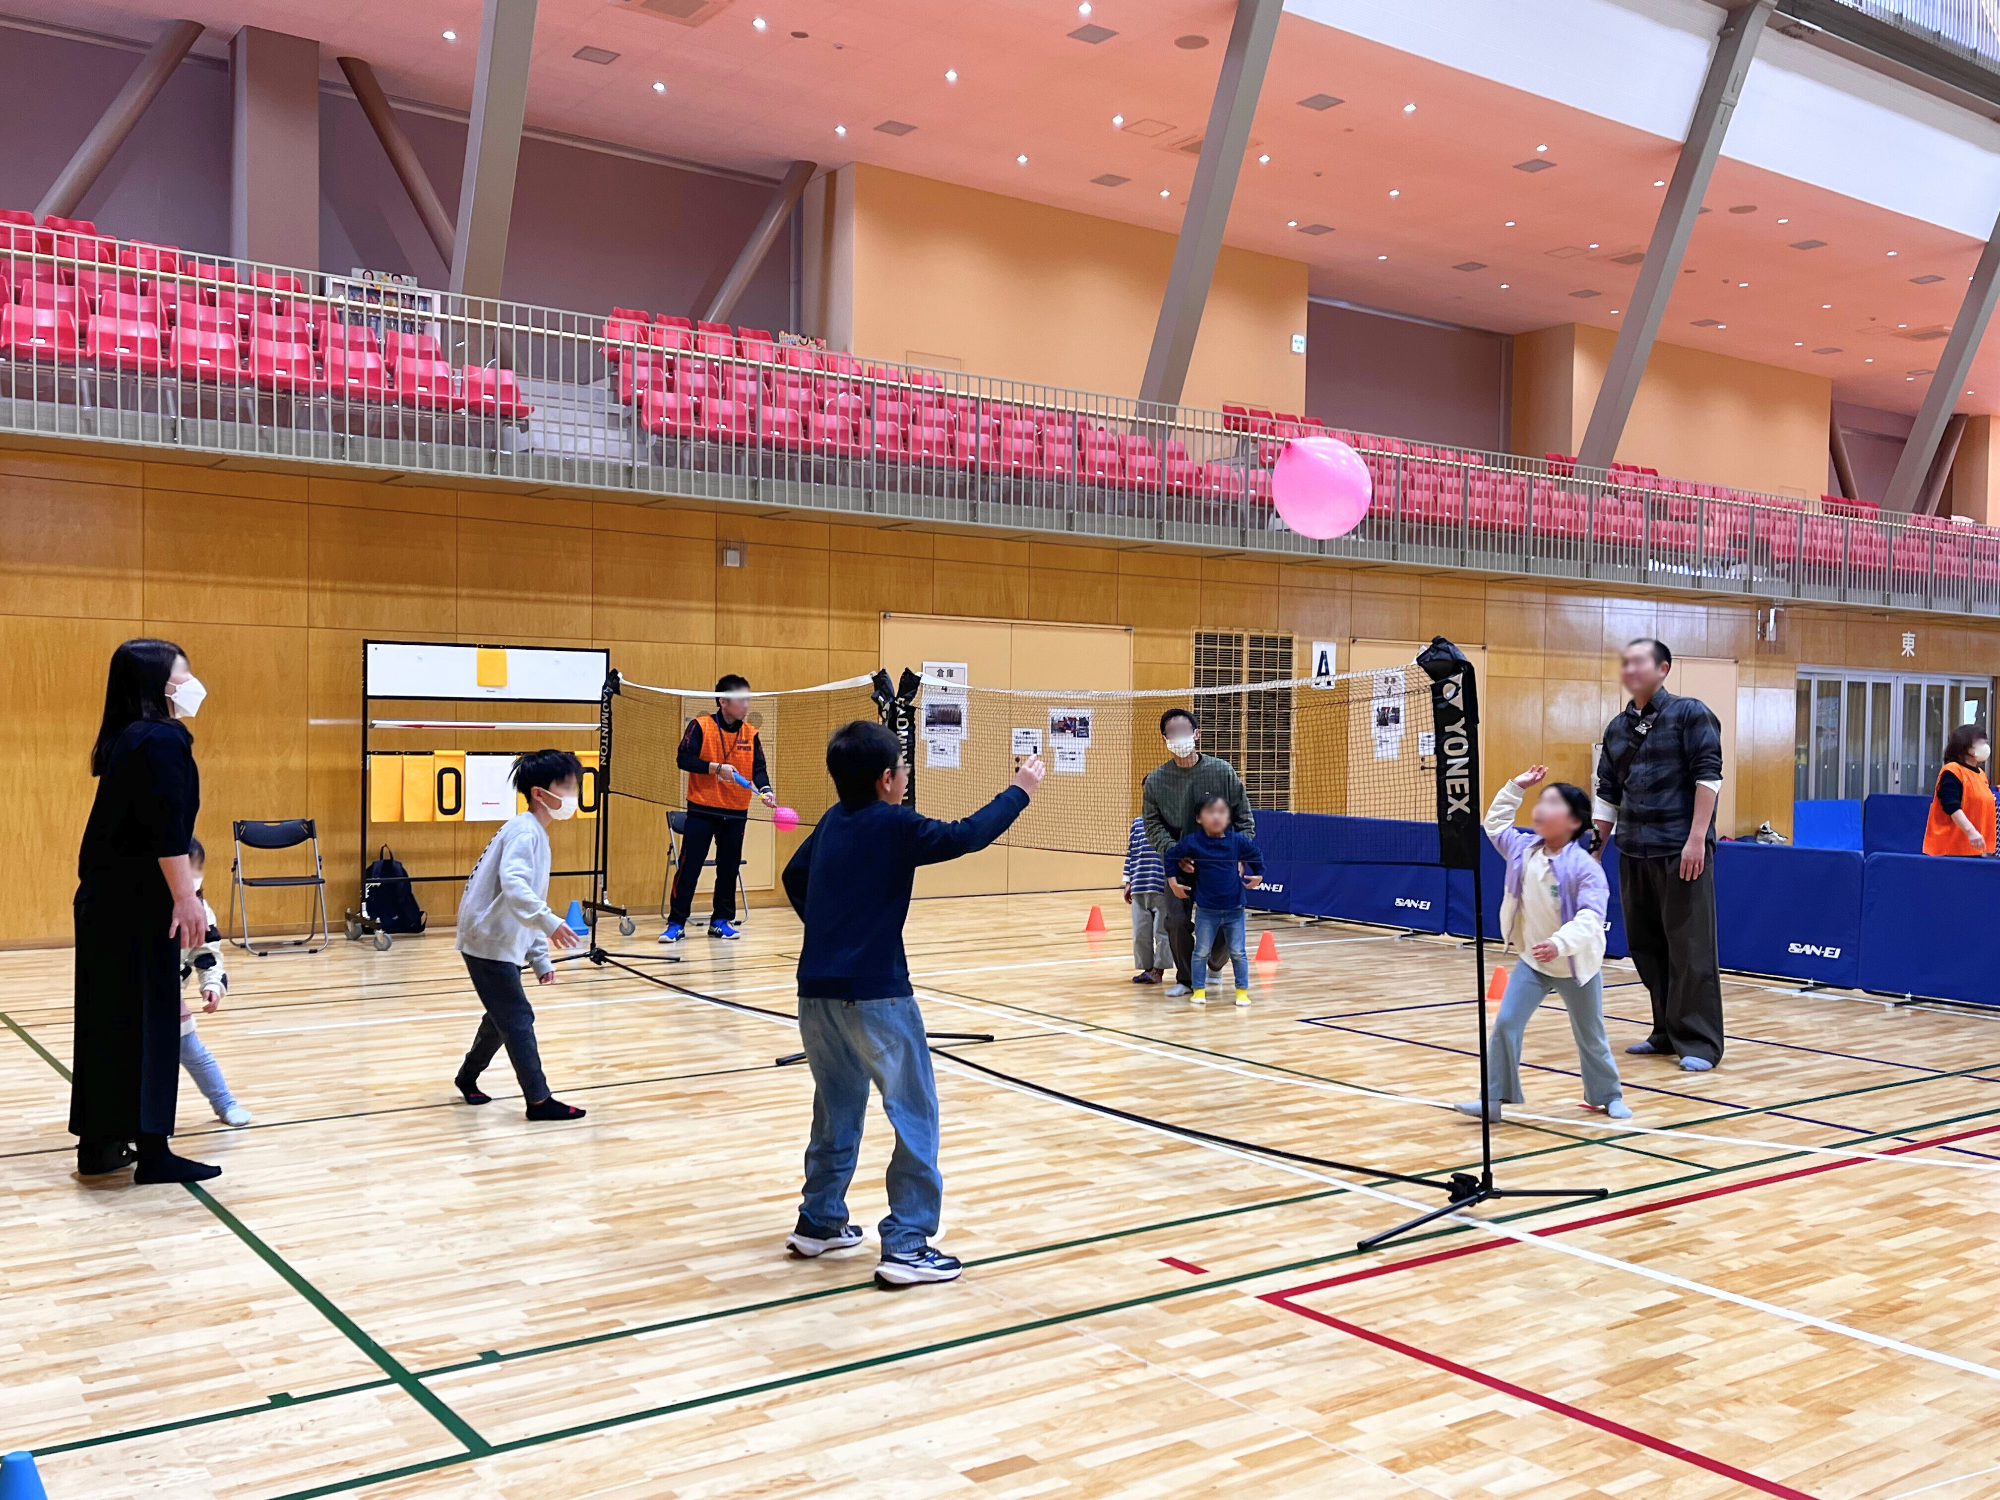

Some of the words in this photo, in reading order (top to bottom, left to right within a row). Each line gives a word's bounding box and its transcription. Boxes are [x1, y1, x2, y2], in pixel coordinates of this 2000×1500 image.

[1901, 631, 1915, 657] 東
[936, 668, 954, 678] 倉庫
[1314, 651, 1332, 686] A
[1443, 717, 1471, 814] YONEX
[437, 767, 462, 816] 0
[1395, 898, 1431, 910] SAN-EI
[1788, 942, 1841, 959] SAN-EI
